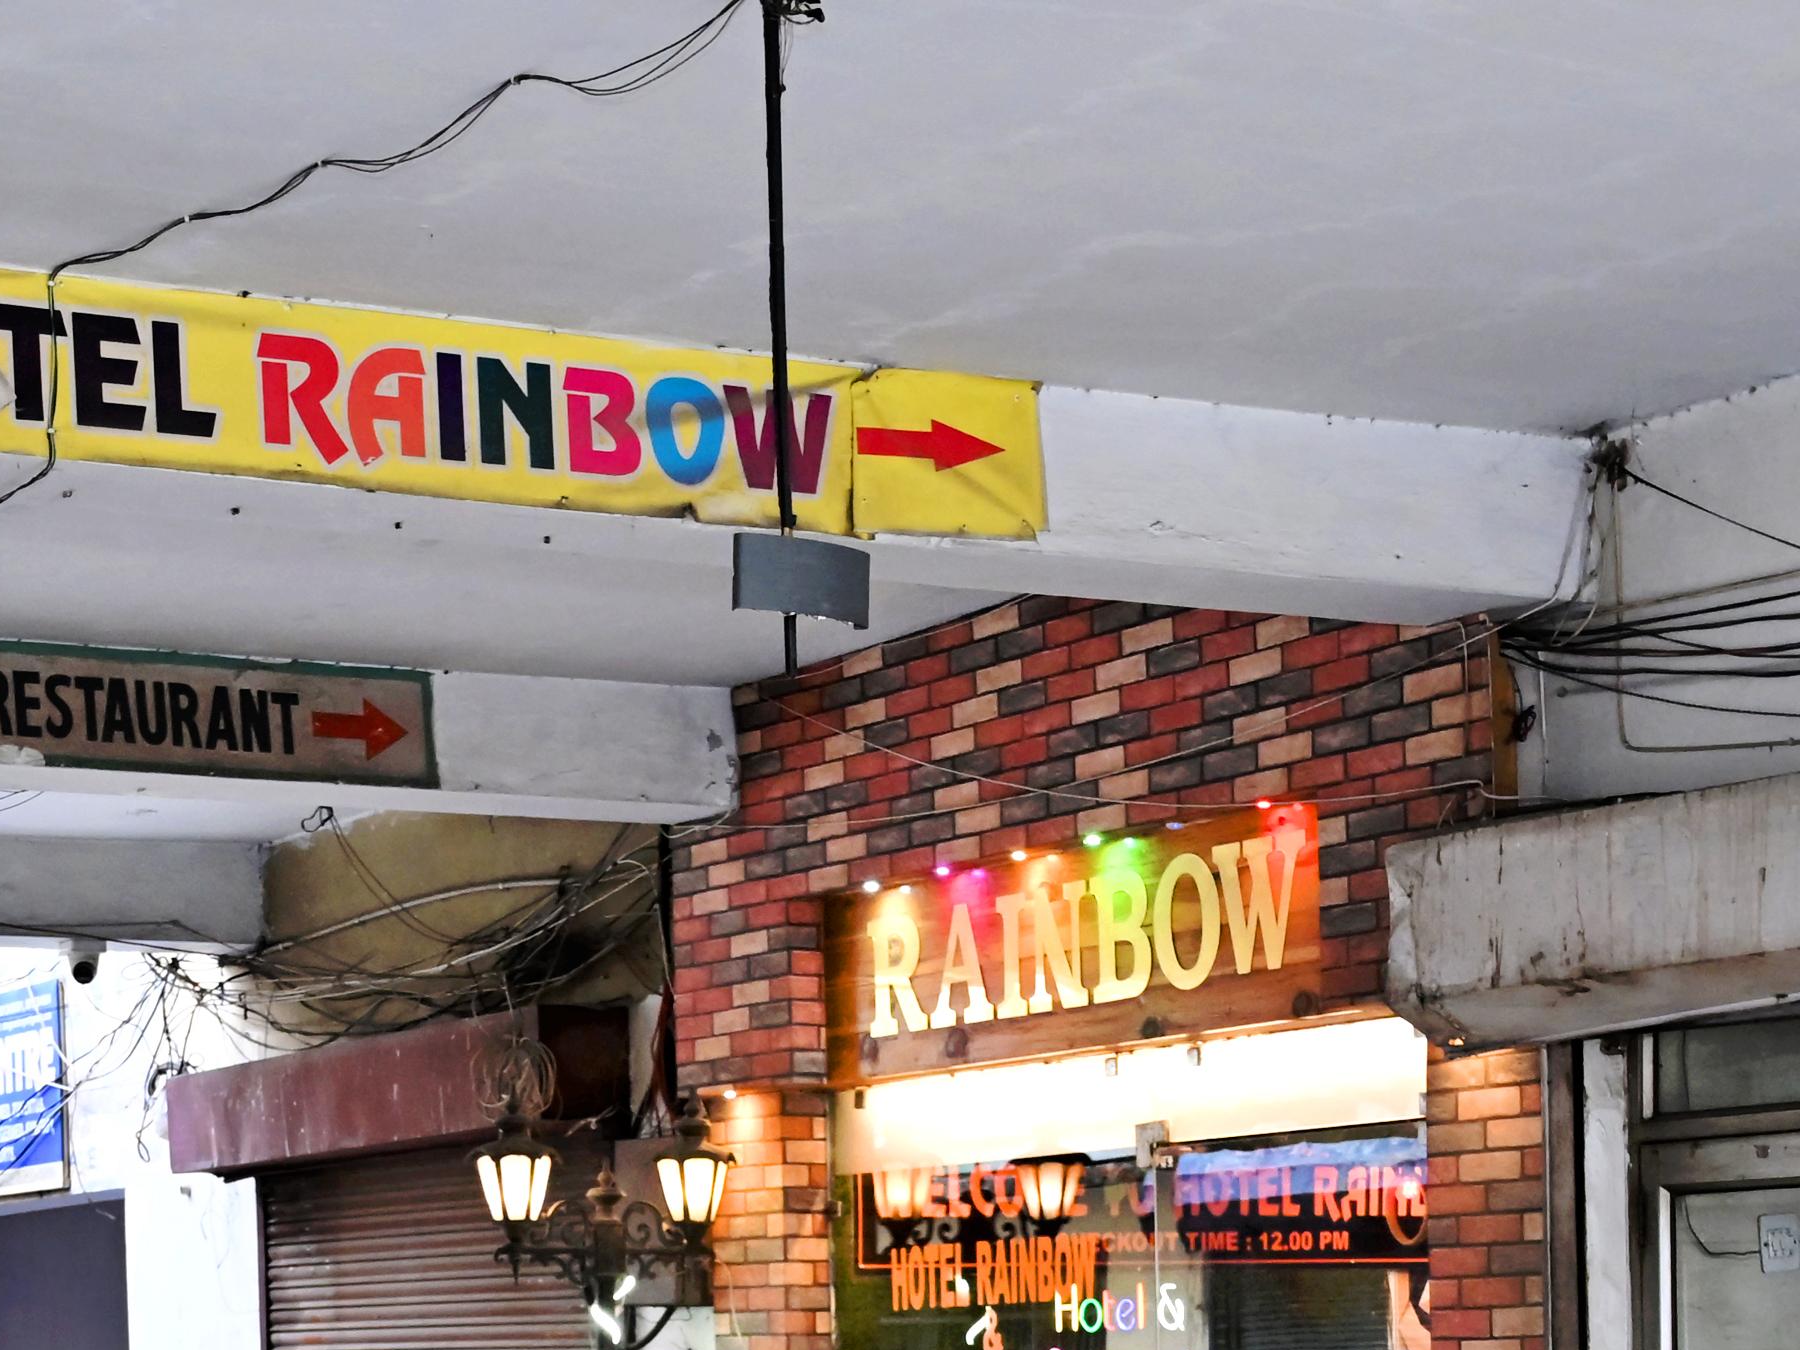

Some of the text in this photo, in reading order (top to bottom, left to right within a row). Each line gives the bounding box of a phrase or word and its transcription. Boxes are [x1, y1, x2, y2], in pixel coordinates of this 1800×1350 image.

[256, 332, 835, 495] RAINBOW
[867, 828, 1307, 1038] RAINBOW
[1173, 1166, 1301, 1217] HOTEL
[890, 1232, 1097, 1312] HOTEL RAINBOW
[1186, 1231, 1239, 1250] TIME
[1259, 1230, 1313, 1250] 12.00
[1319, 1231, 1350, 1250] PM
[1054, 1282, 1186, 1333] Hotel &
